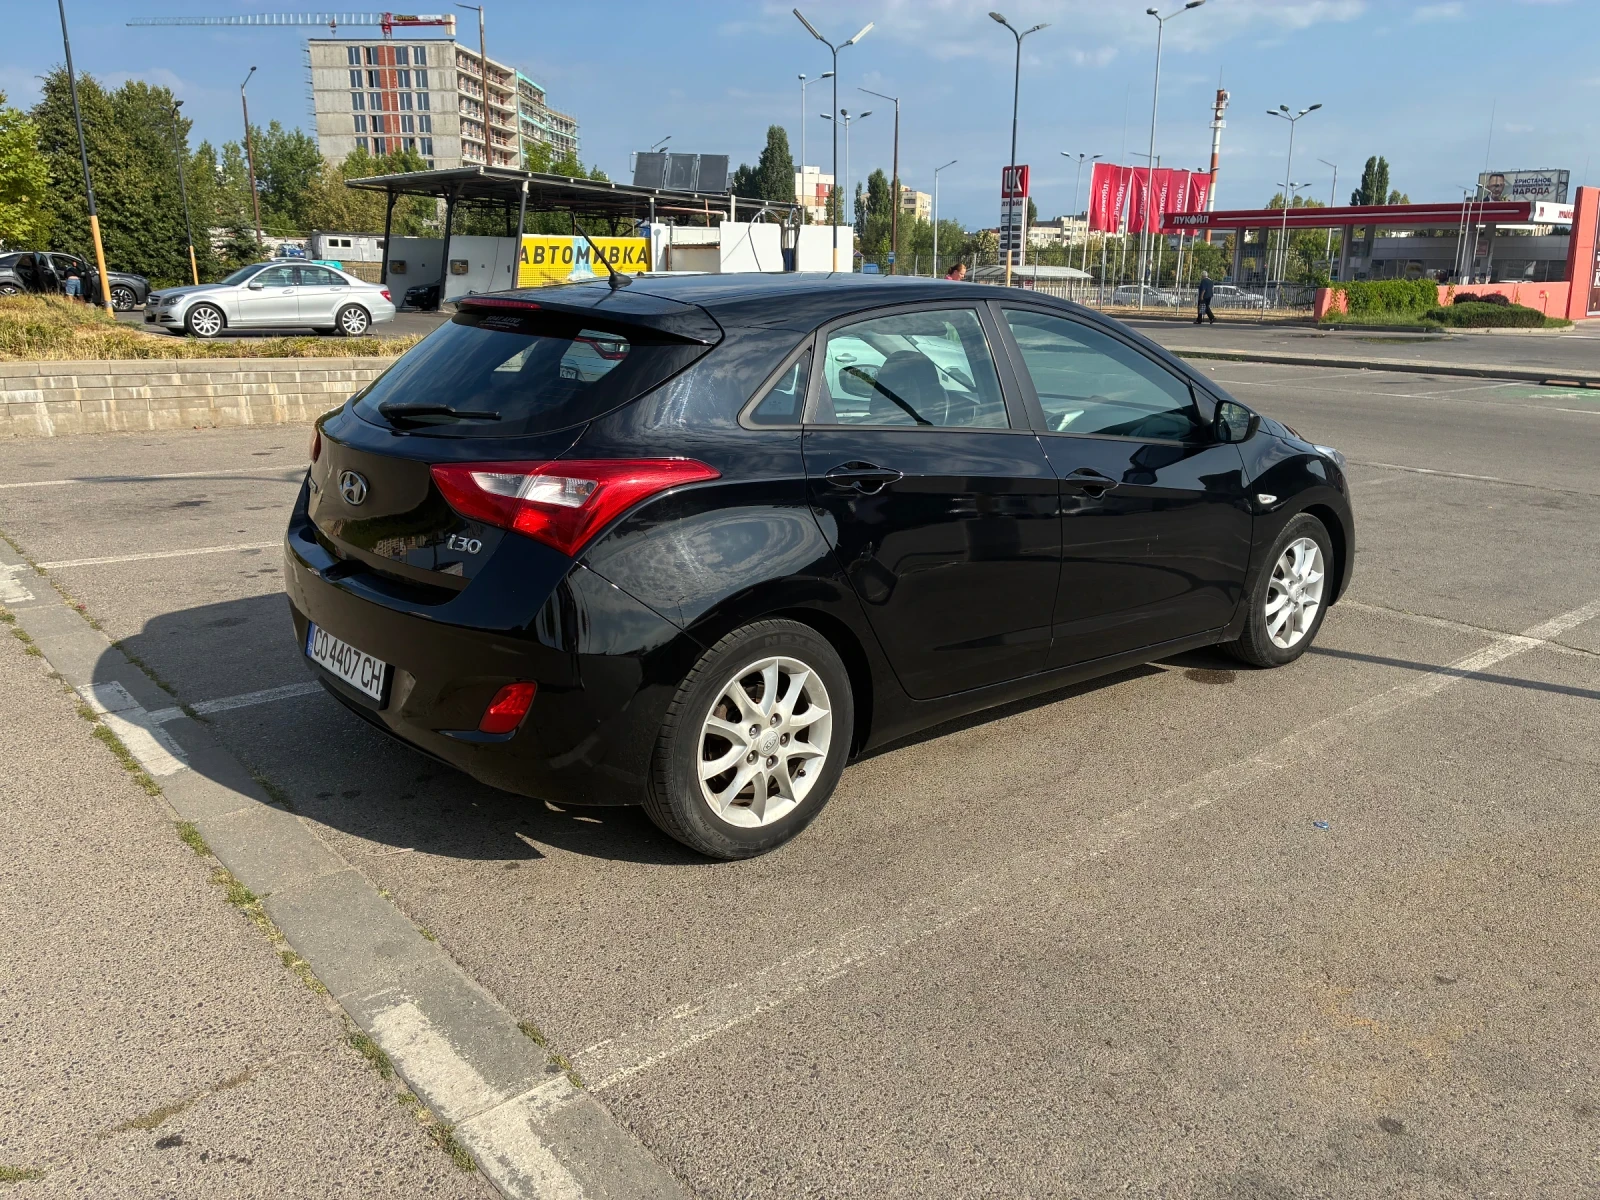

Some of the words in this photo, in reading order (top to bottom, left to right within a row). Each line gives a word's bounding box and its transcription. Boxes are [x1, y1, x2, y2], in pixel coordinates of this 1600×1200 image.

[1175, 189, 1184, 213] УКОЙЛ
[1512, 187, 1550, 196] НАРОДА
[1172, 214, 1209, 225] ЛУКОЙЛ
[520, 245, 648, 265] АВТОМИВКА
[446, 533, 482, 554] i30
[313, 628, 329, 661] CO
[329, 639, 361, 680] 4407
[361, 657, 383, 695] CH
